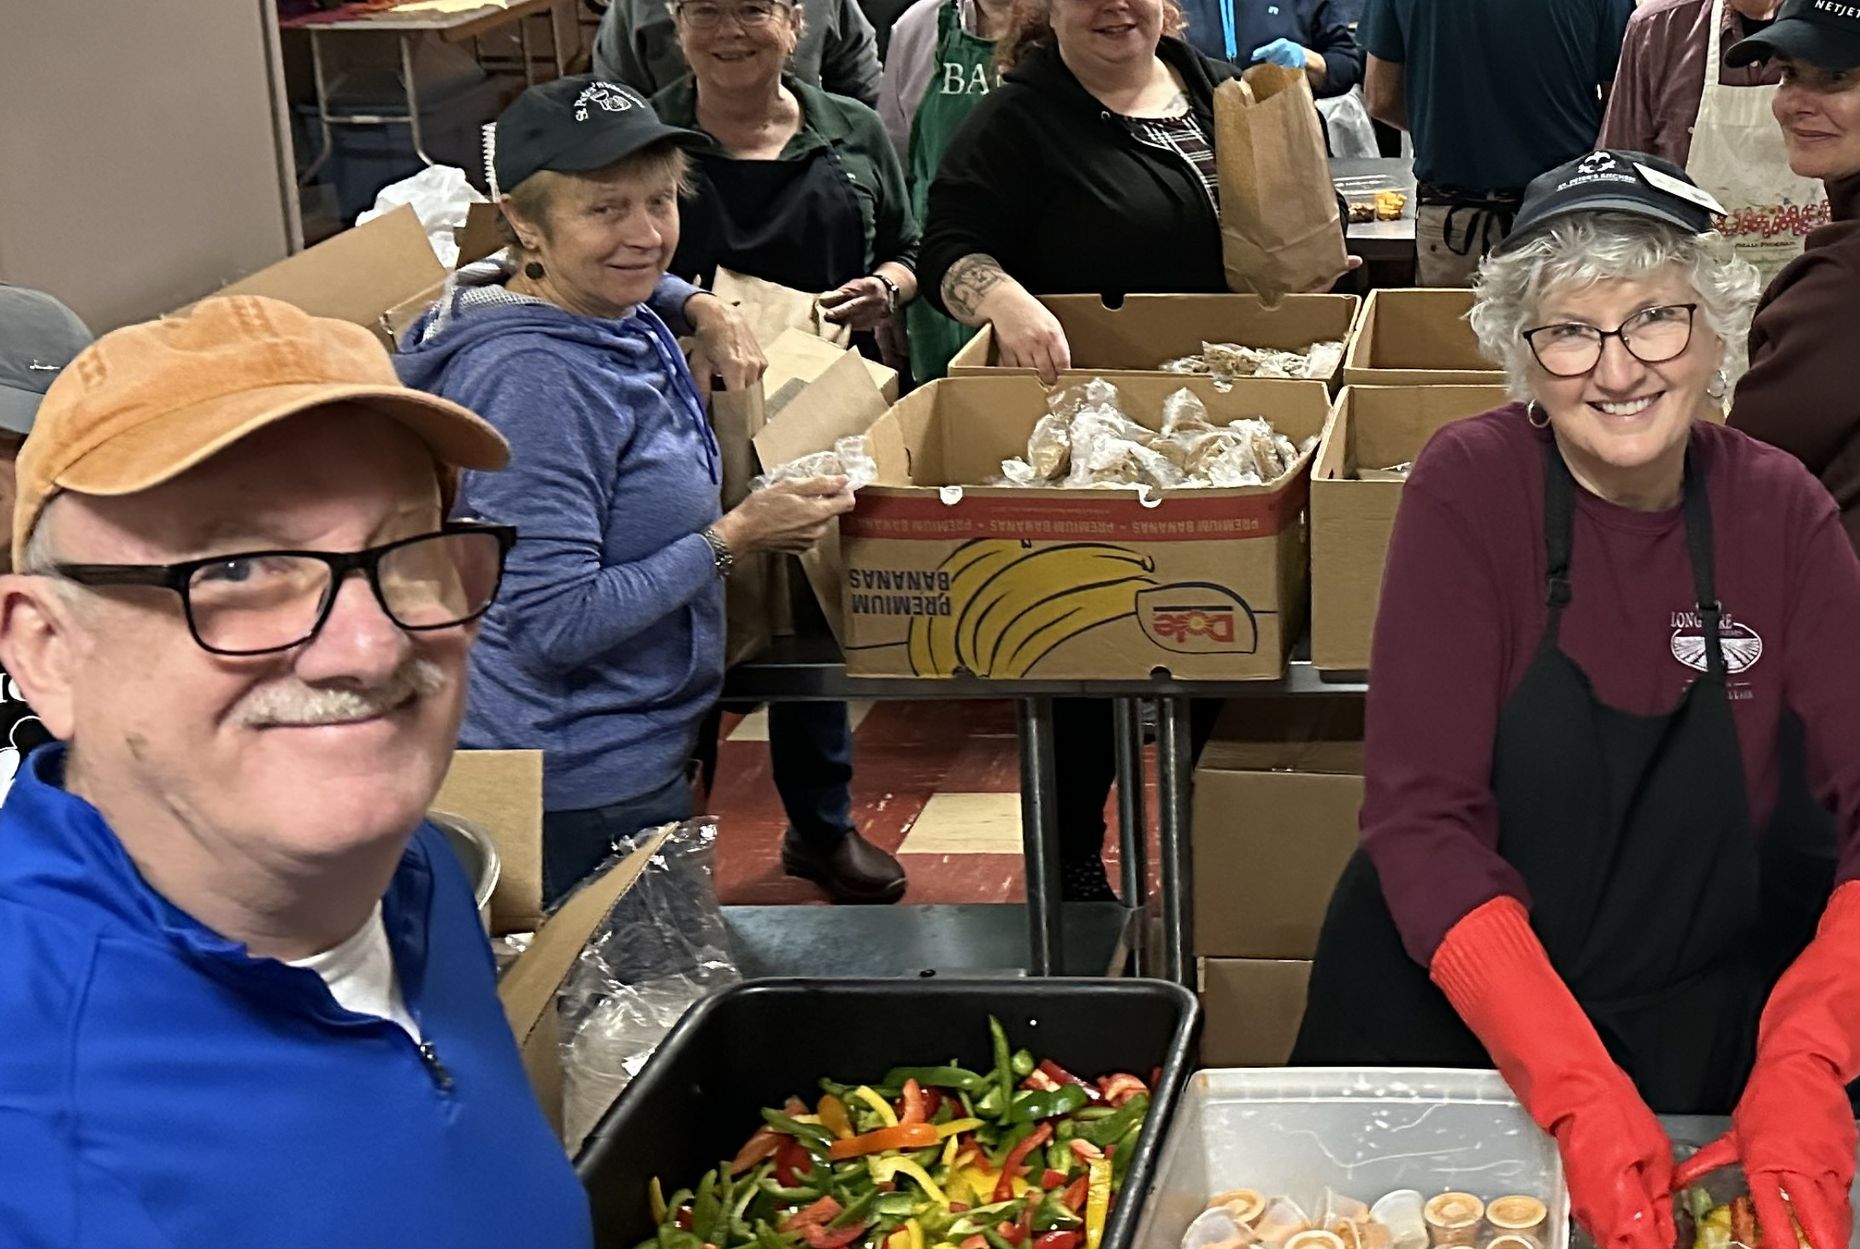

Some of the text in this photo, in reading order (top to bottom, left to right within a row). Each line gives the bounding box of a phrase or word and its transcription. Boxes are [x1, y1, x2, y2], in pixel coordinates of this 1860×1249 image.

[911, 518, 972, 532] PREMIUM
[990, 519, 1114, 534] PREMIUM BANANAS
[1132, 518, 1259, 534] PREMIUM BANANAS
[850, 569, 949, 590] BANANAS
[852, 595, 951, 616] PREMIUM
[1153, 611, 1234, 643] Dole
